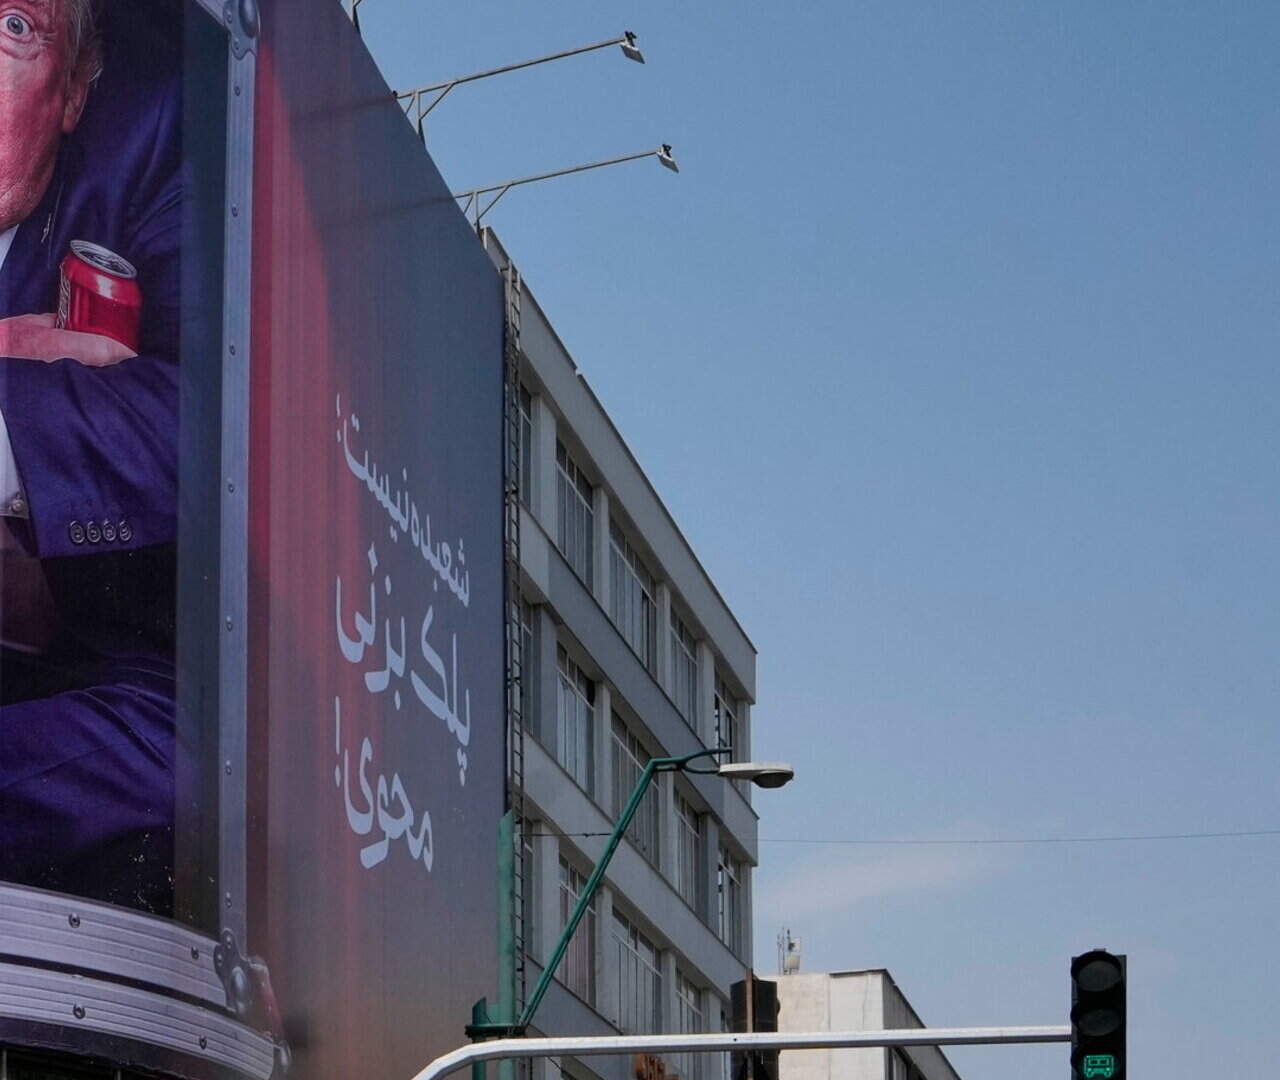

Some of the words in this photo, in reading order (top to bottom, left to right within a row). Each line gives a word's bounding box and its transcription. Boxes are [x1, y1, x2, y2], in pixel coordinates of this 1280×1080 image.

[335, 541, 405, 711] بزنی
[411, 501, 470, 608] شعبده
[410, 605, 470, 787] پلک
[334, 695, 433, 873] محوی!
